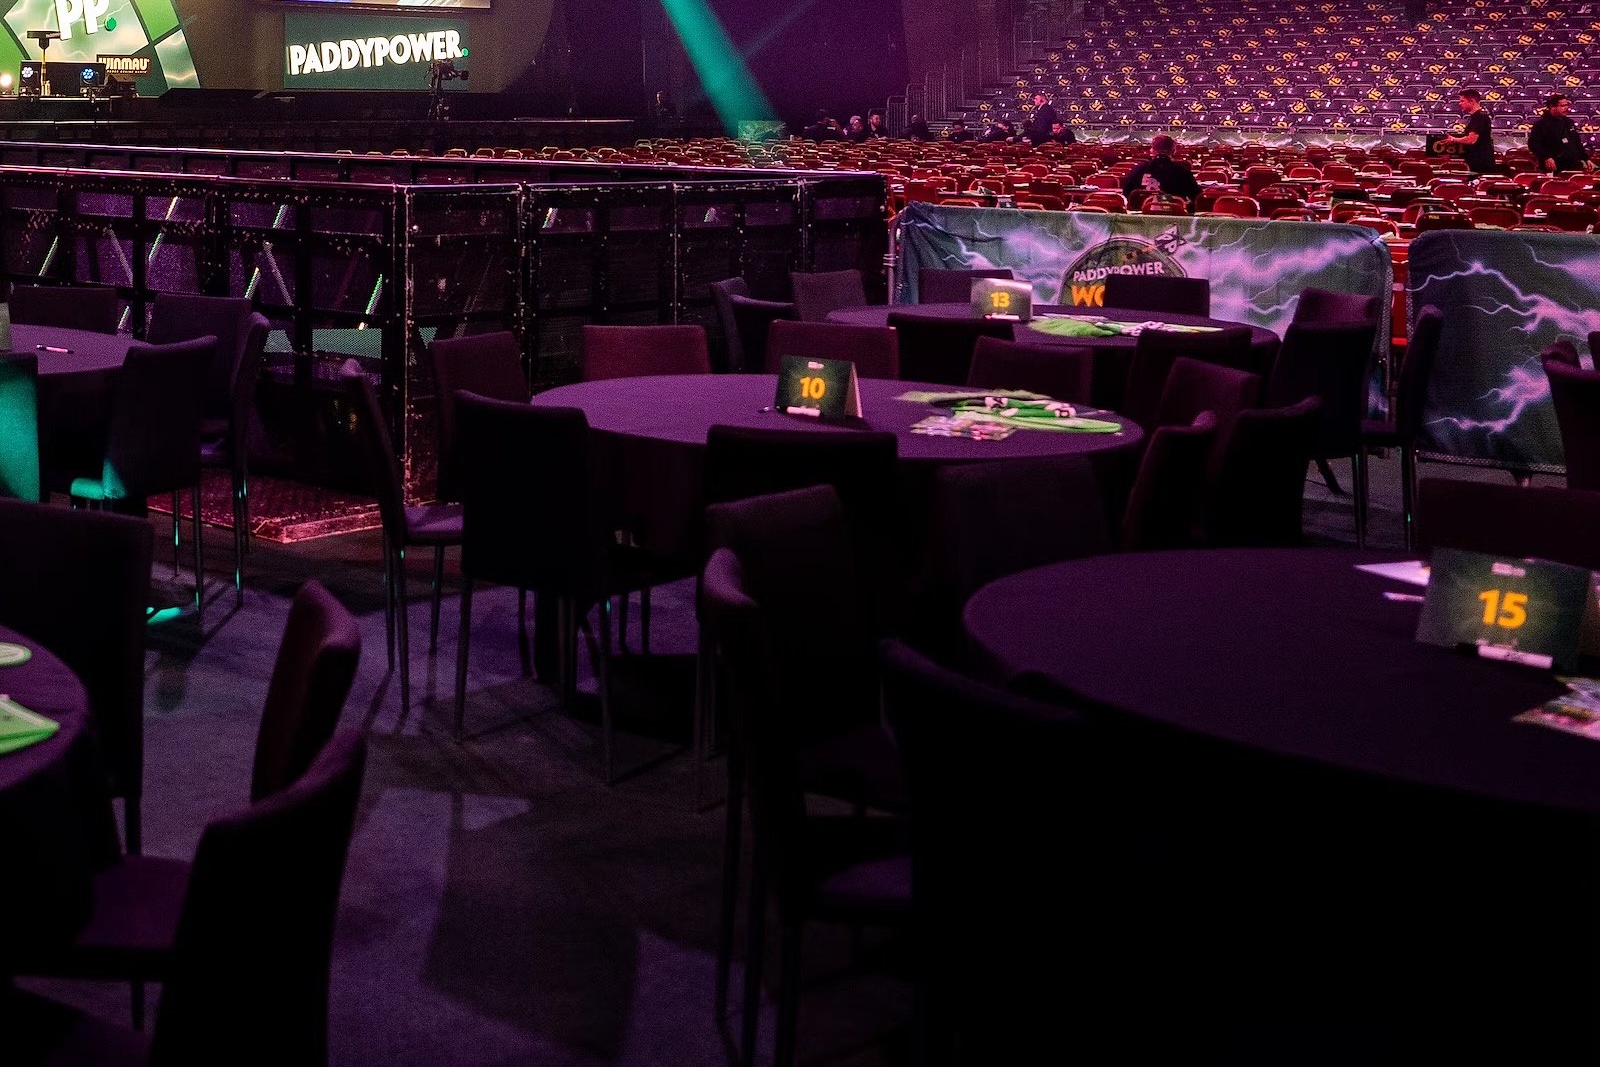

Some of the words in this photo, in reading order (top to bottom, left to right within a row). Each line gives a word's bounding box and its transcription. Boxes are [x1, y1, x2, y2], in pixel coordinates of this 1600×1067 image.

[991, 292, 1010, 308] 13
[800, 376, 826, 400] 10
[1478, 588, 1529, 629] 15
